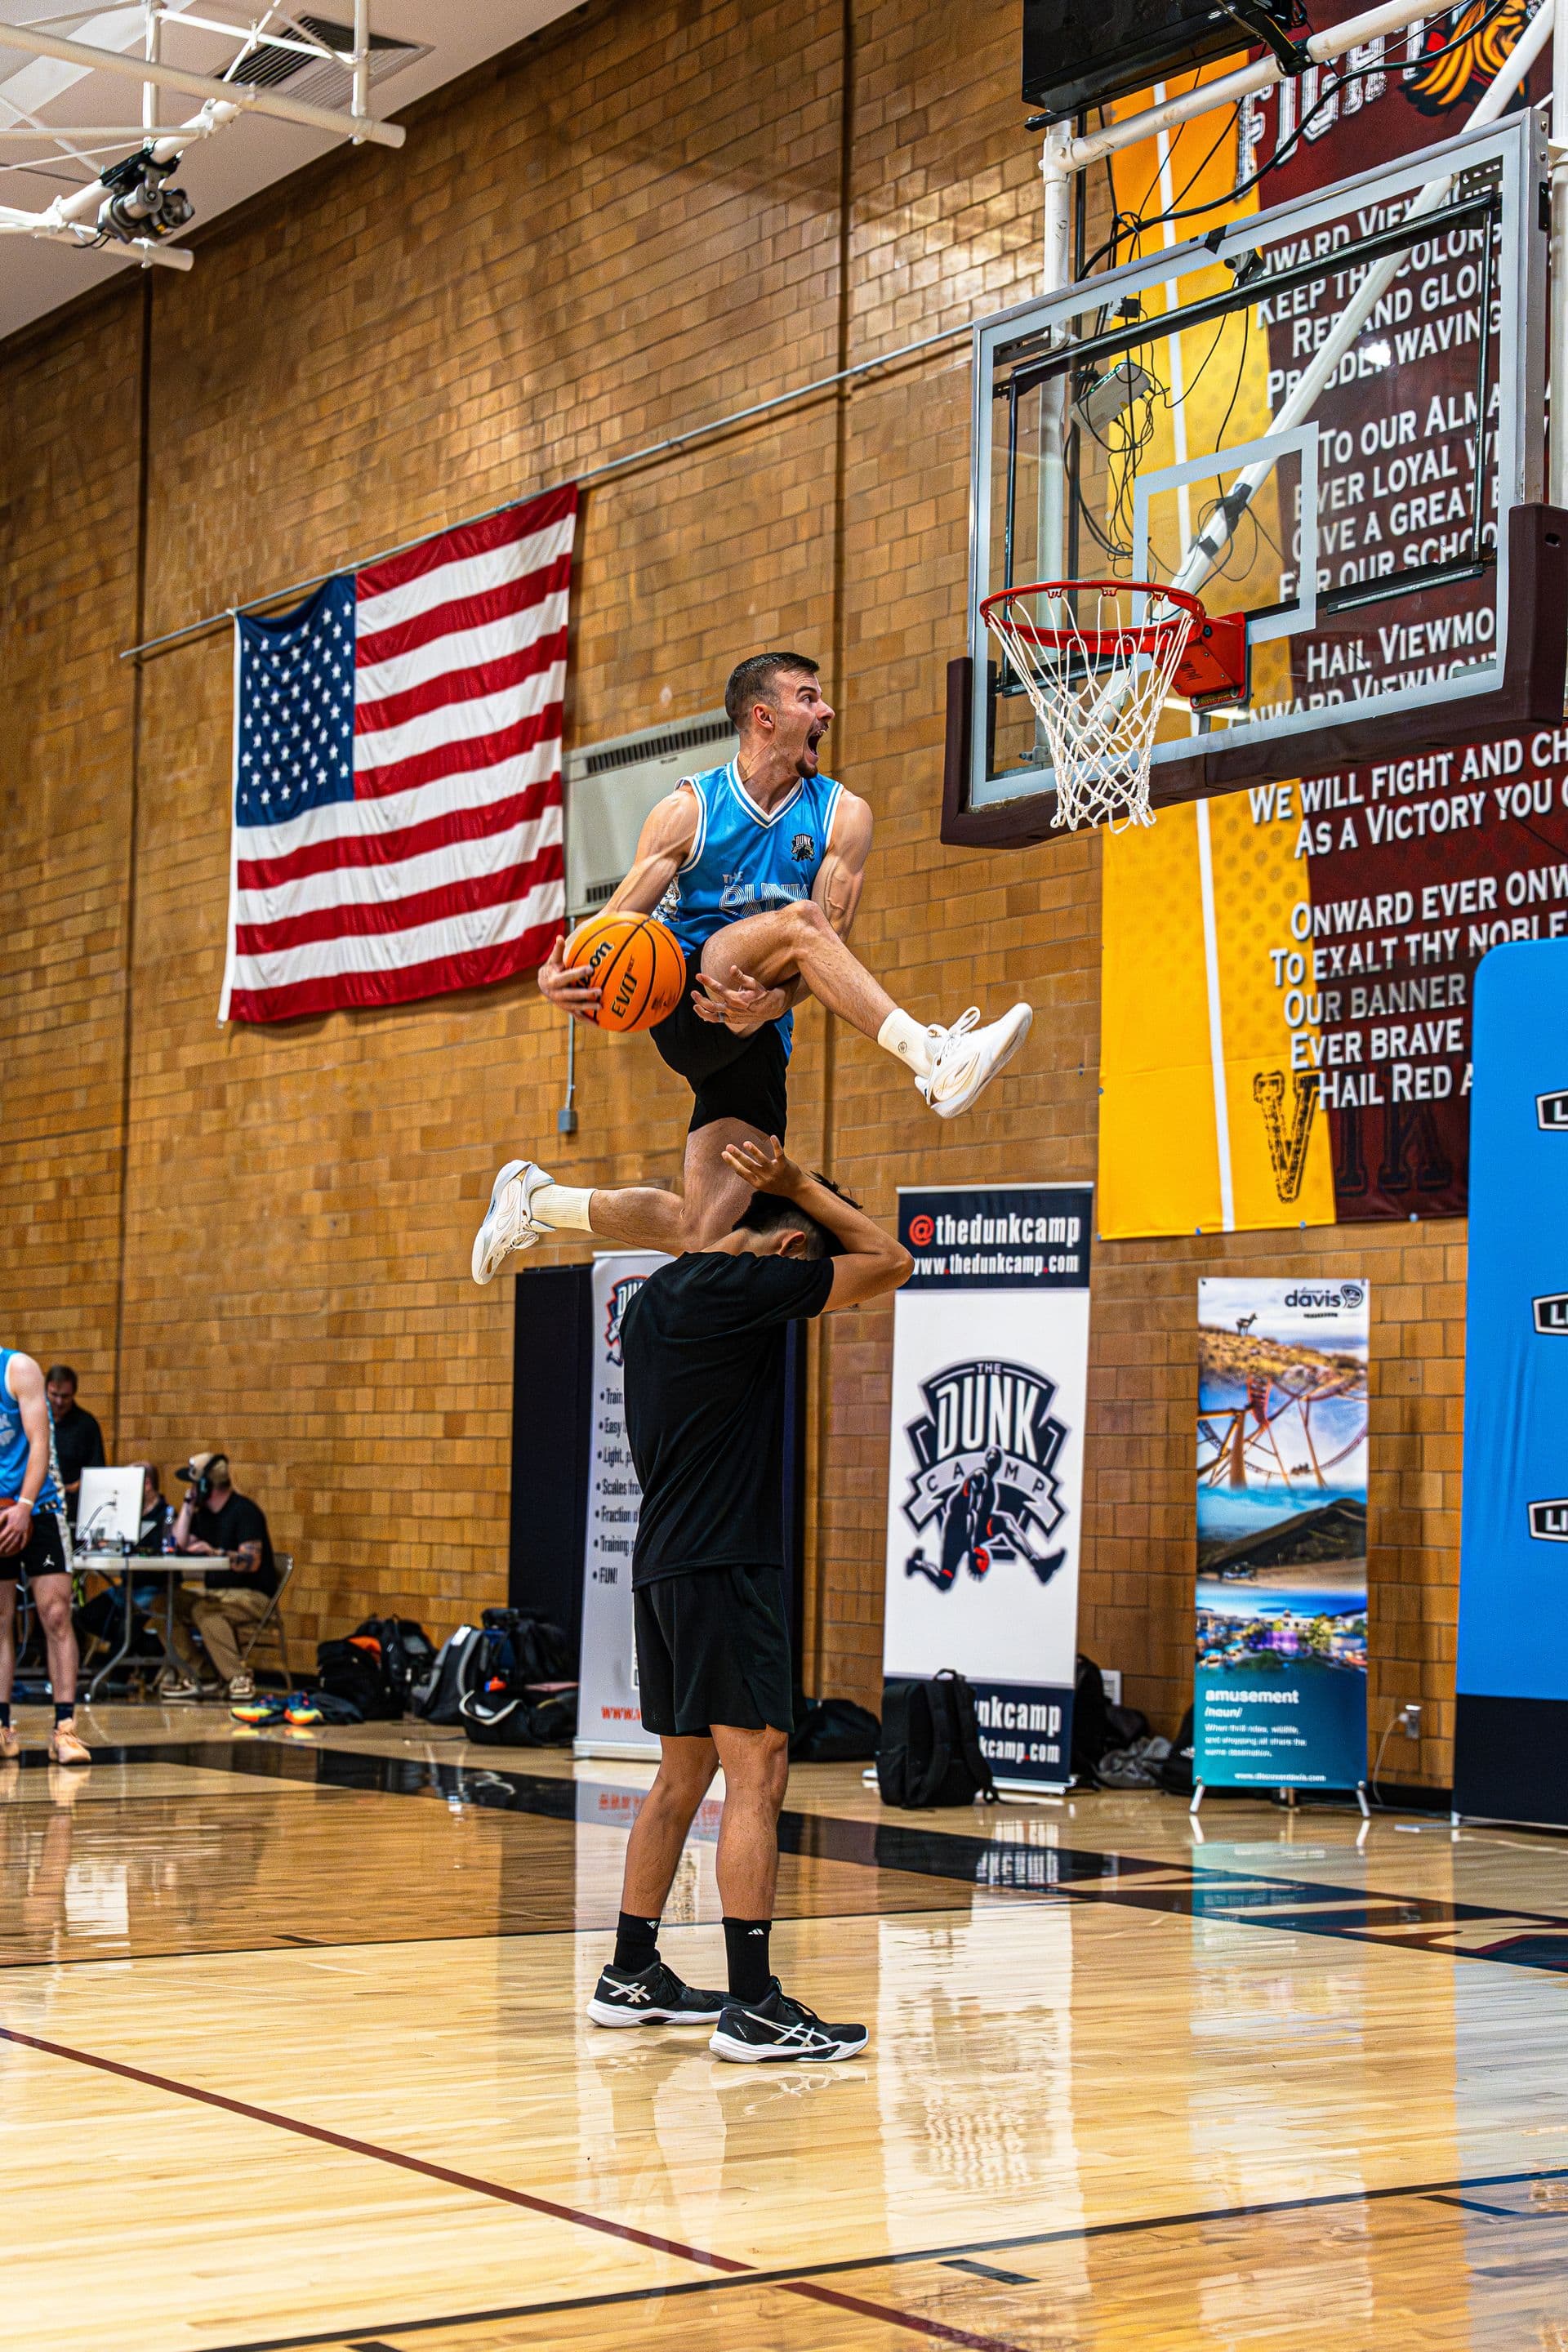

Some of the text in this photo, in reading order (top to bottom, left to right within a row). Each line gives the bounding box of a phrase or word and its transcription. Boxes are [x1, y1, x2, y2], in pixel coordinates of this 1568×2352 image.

[1319, 428, 1354, 468] TO
[1361, 409, 1417, 456] OUR
[1373, 446, 1459, 499] LOYAL
[1363, 510, 1383, 545] A
[1339, 550, 1396, 586] OUR
[1307, 639, 1371, 684] HAIL
[1248, 783, 1293, 824] WE
[1299, 773, 1365, 813] WILL
[1371, 751, 1454, 800] FIGHT
[1459, 738, 1524, 783] AND
[1294, 819, 1333, 859] AS
[1339, 817, 1359, 851] A
[1365, 791, 1486, 844] VICTORY
[1493, 778, 1553, 821] YOU
[723, 871, 743, 883] THE
[1290, 891, 1414, 941] ONWARD
[1422, 876, 1499, 920] EVER
[1269, 947, 1304, 986] TO
[1312, 937, 1399, 980] EXALT
[1404, 928, 1461, 967] THY
[611, 972, 638, 1018] EVO
[1283, 973, 1467, 1028] OUR BANNER
[1290, 1018, 1464, 1071] EVER BRAVE
[1319, 1071, 1385, 1111] HAIL
[1392, 1062, 1453, 1104] RED
[908, 1213, 1081, 1248] @thedunkcamp
[1285, 1290, 1341, 1307] davis
[977, 1363, 1003, 1374] THE
[605, 1417, 621, 1437] Easy
[936, 1374, 1040, 1463] DUNK
[602, 1477, 628, 1495] Scales
[926, 1461, 1046, 1494] CAMP
[602, 1505, 631, 1523] Fraction
[600, 1535, 630, 1557] Training
[599, 1566, 619, 1584] FUN!
[1205, 1690, 1299, 1704] amusement
[1205, 1706, 1243, 1718] /noun/
